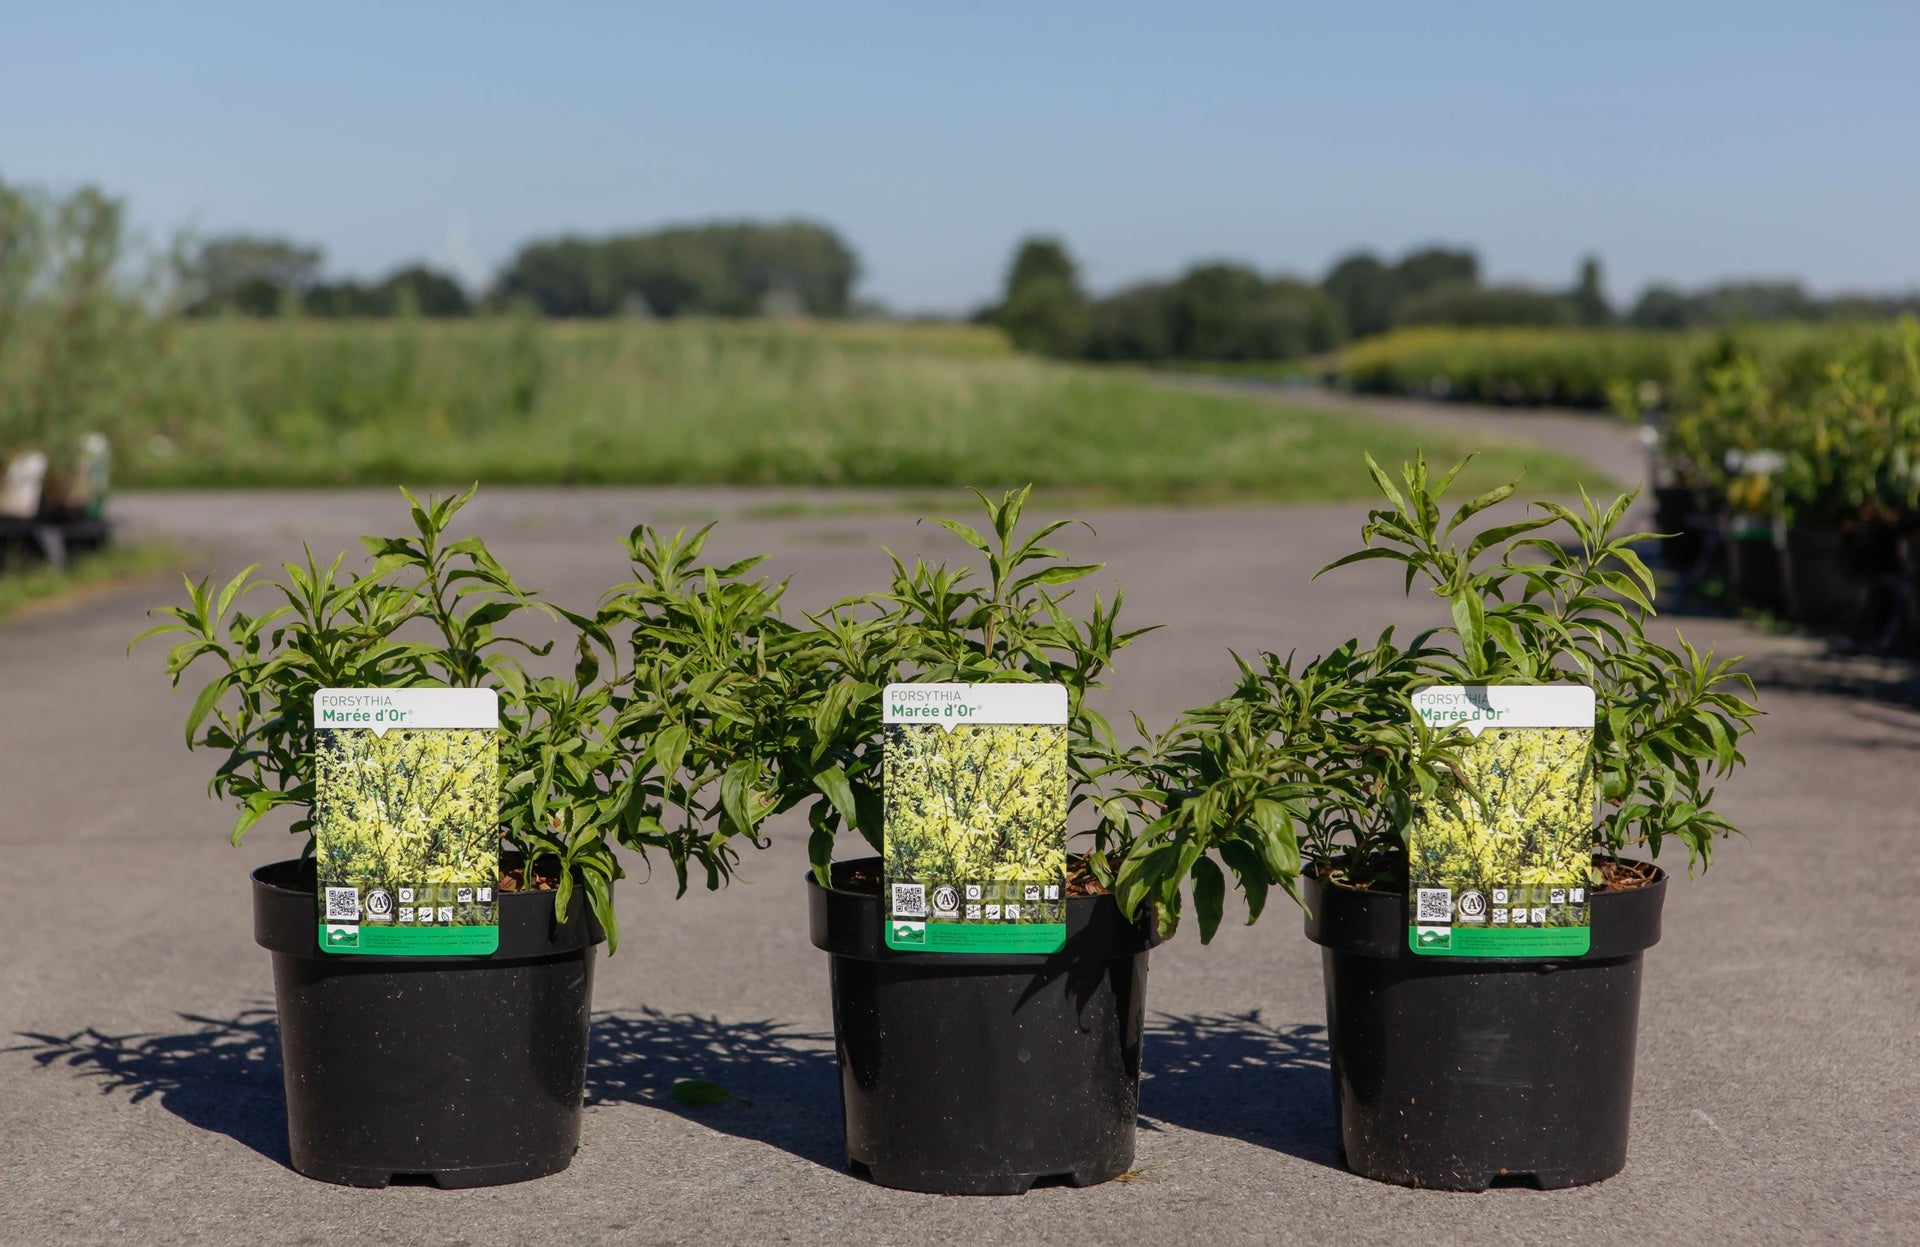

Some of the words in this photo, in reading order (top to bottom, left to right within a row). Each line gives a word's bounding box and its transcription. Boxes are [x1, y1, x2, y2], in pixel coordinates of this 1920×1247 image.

[322, 695, 393, 707] FORSYTHIA
[891, 690, 962, 702] FORSYTHIA
[1420, 693, 1490, 705] FORSYTHIA
[323, 708, 371, 722] Marée
[891, 703, 940, 717] Marée
[1420, 706, 1468, 721] Marée
